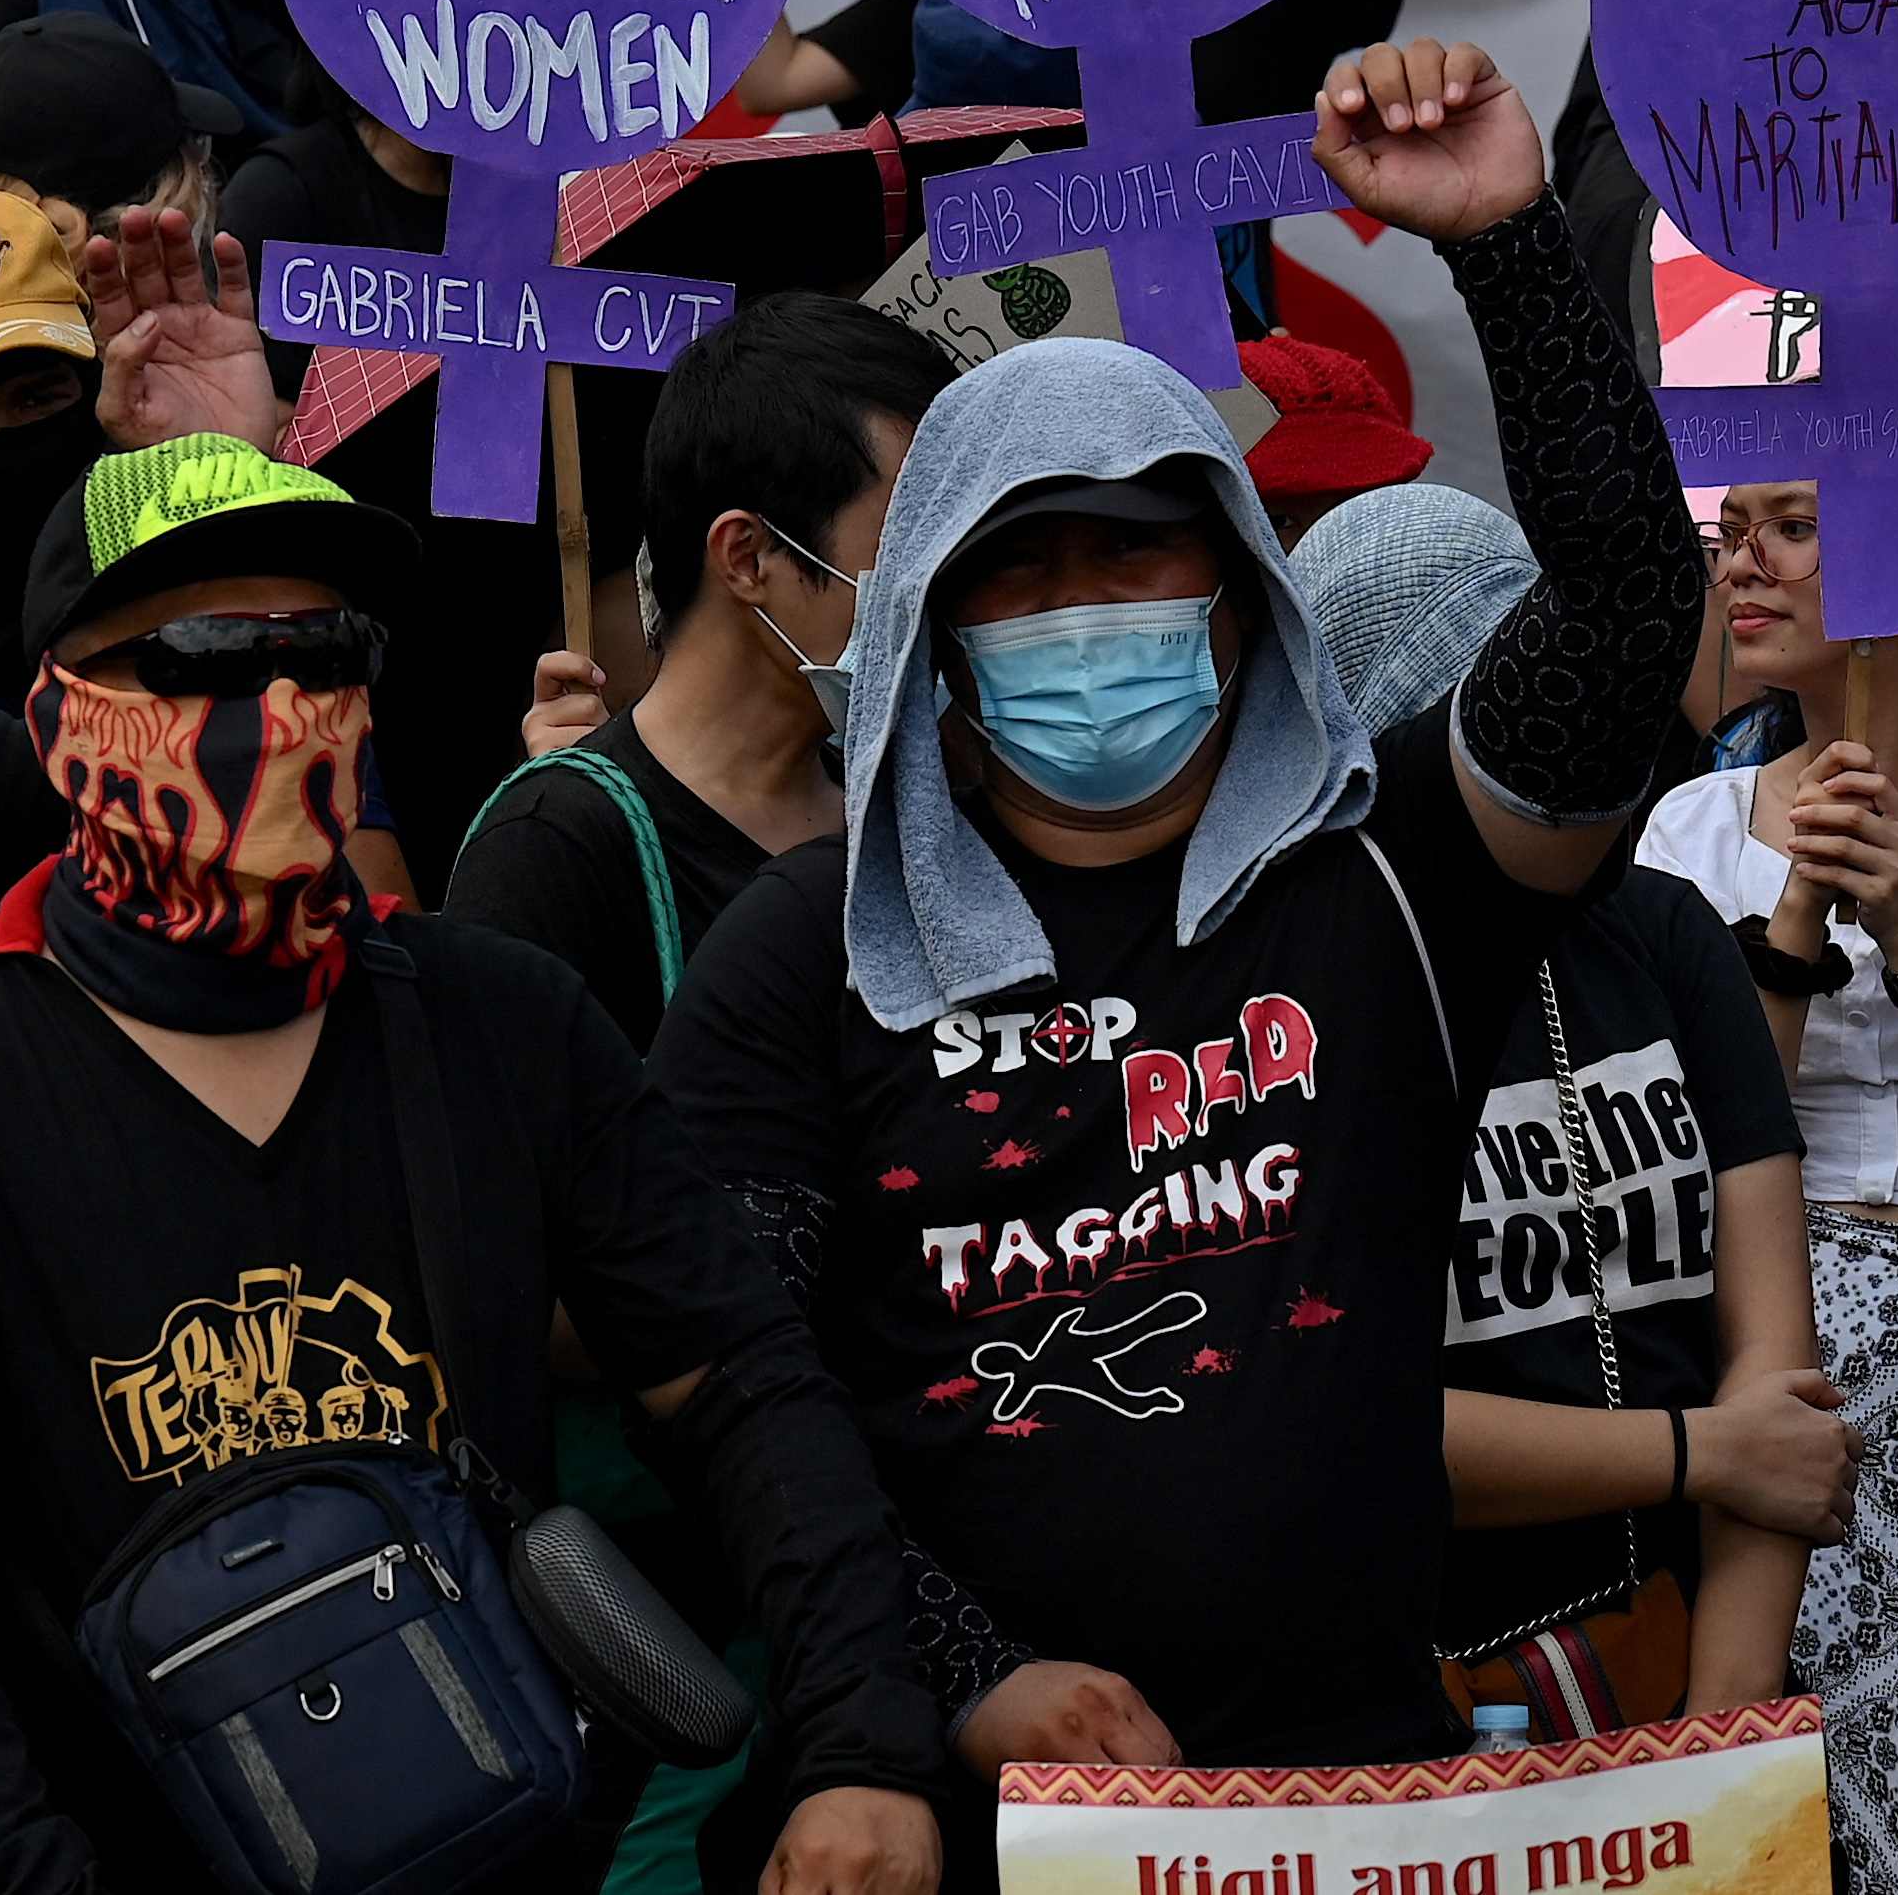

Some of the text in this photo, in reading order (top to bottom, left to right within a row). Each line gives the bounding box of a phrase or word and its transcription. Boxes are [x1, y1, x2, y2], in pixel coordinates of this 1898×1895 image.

[1744, 44, 1829, 104] TO
[933, 175, 1025, 269] GAB
[1030, 153, 1181, 249] YOUTH
[279, 255, 725, 358] GABRIELA CVT
[1662, 408, 1788, 463] GABRIELA
[1796, 407, 1875, 452] YOUTH
[932, 996, 1139, 1079] STOP
[1121, 992, 1319, 1174] RED
[921, 1141, 1304, 1314] TAGGING
[1135, 1818, 1695, 1895] Itigil ang mga
